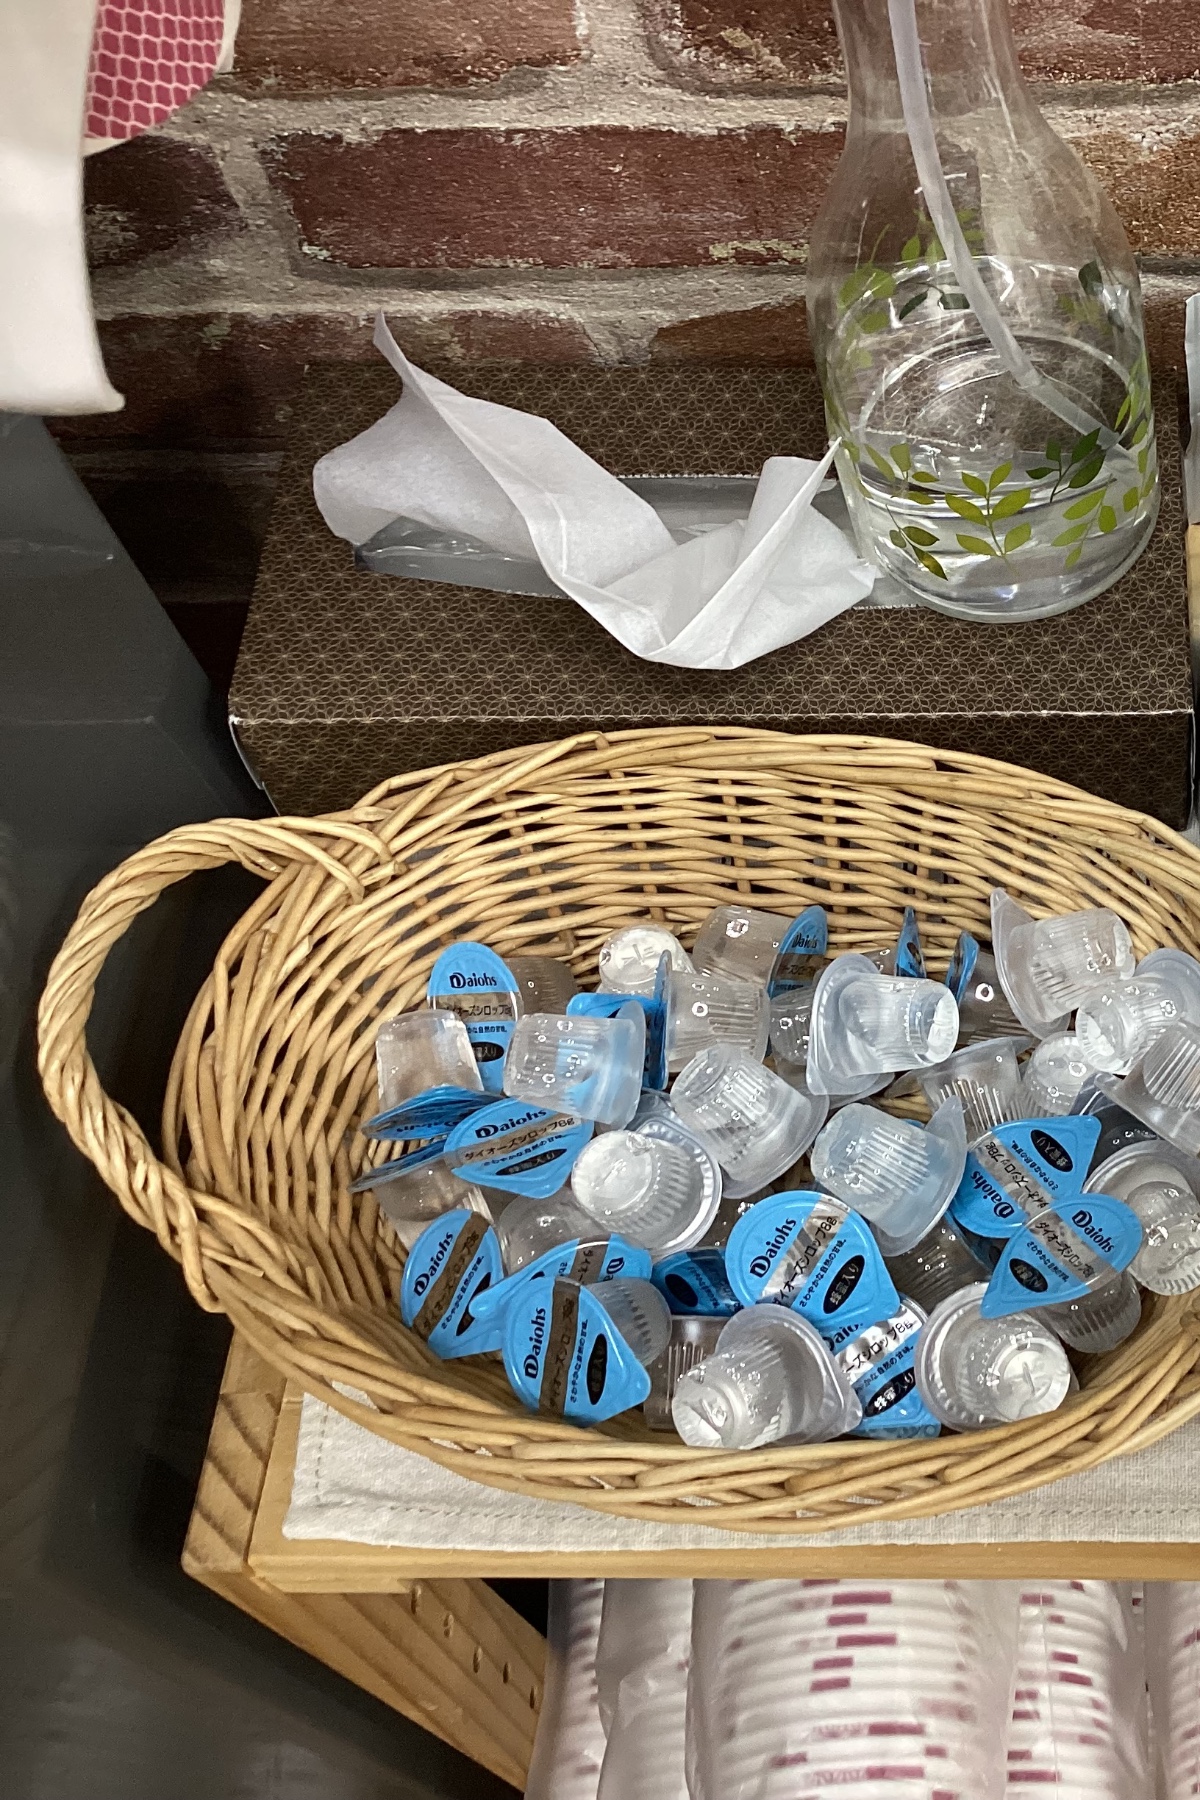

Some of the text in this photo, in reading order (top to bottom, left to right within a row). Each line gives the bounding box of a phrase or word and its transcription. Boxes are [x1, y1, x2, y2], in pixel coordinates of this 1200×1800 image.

[449, 972, 498, 989] Daiohs
[464, 1116, 576, 1161] ダイオーズシロップ8g
[475, 1108, 548, 1139] Daiohs
[969, 1170, 1015, 1219] Daiohs
[749, 1217, 797, 1279] Daiohs
[1071, 1209, 1115, 1254] Daiohs
[413, 1231, 454, 1297] Daiohs
[523, 1306, 547, 1379] Daiohs
[843, 1319, 917, 1373] ーズシロップ8g
